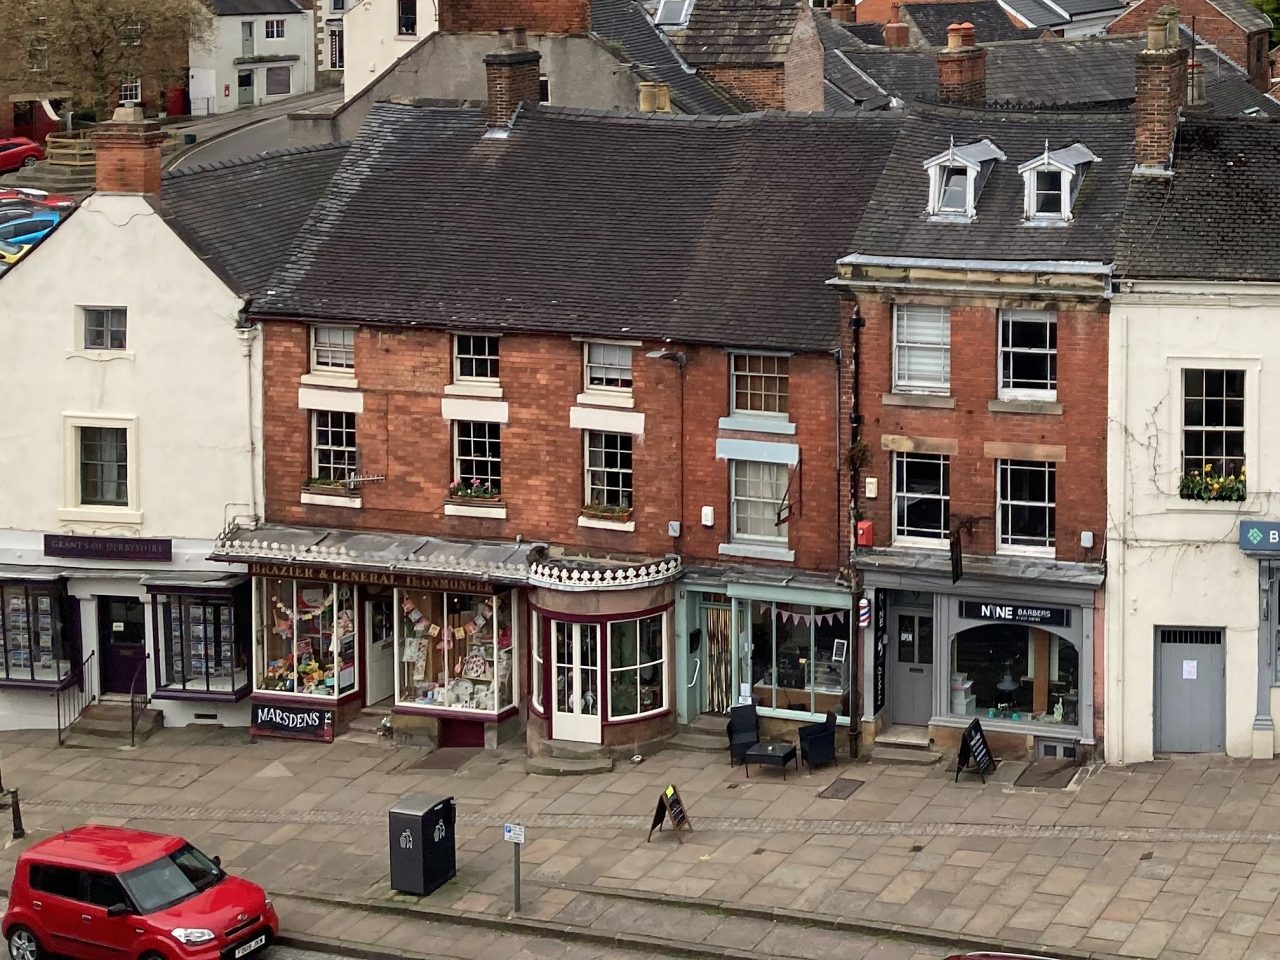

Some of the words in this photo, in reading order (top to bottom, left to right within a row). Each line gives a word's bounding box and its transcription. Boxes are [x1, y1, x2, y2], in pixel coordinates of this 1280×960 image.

[106, 543, 162, 553] DERBYSHIRE
[252, 563, 314, 579] BRAZIER
[319, 569, 328, 579] &
[332, 570, 398, 585] GENERAL
[405, 576, 493, 593] IRONMONGER
[1017, 608, 1051, 618] BARBERS
[900, 632, 913, 642] OPEN
[257, 707, 320, 728] MARSDEN'S
